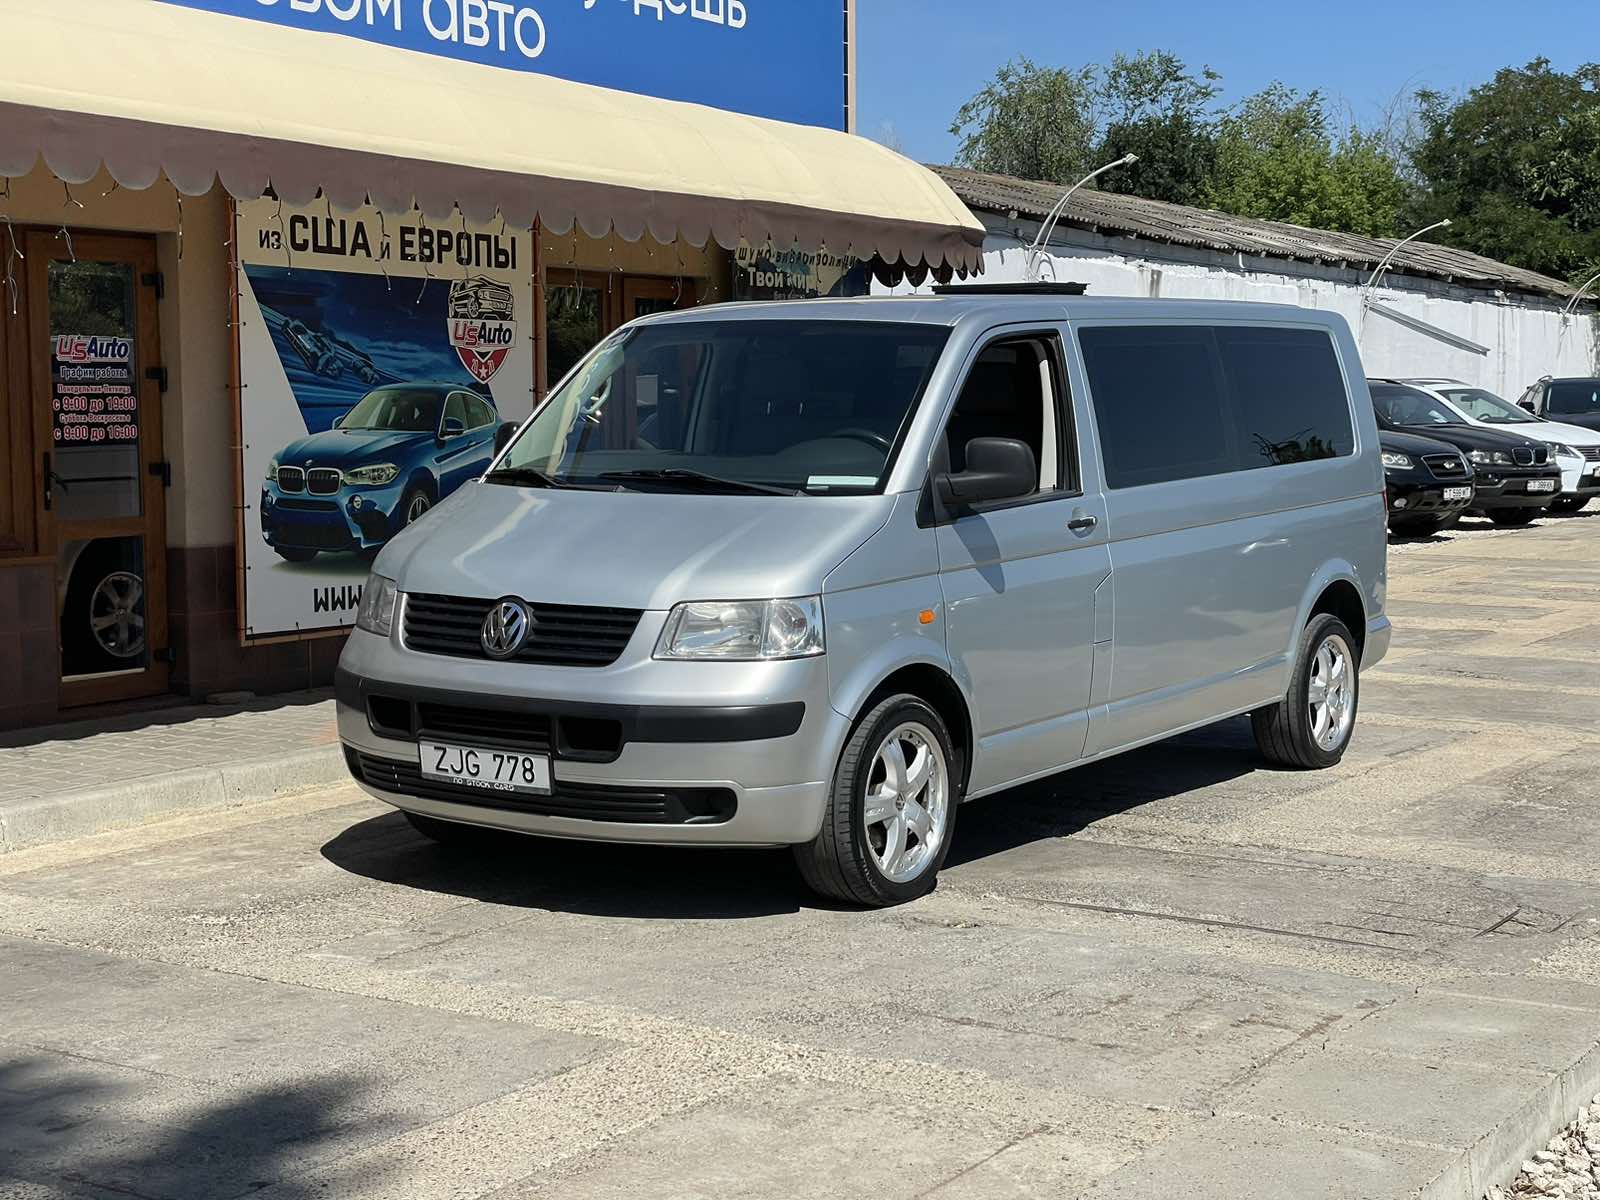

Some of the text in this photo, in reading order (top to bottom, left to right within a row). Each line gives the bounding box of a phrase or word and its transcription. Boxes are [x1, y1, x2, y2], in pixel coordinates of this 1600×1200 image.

[422, 0, 546, 58] авто
[289, 214, 373, 258] США
[400, 225, 517, 270] ЕВРОПЫ
[748, 266, 784, 288] Твой
[60, 366, 128, 380] График работы
[62, 397, 87, 411] 9:00
[89, 399, 104, 412] до
[106, 397, 136, 411] 19:00
[63, 425, 88, 439] 9:00
[90, 428, 105, 441] до
[107, 425, 138, 439] 16:00
[433, 746, 535, 784] ZJG 778
